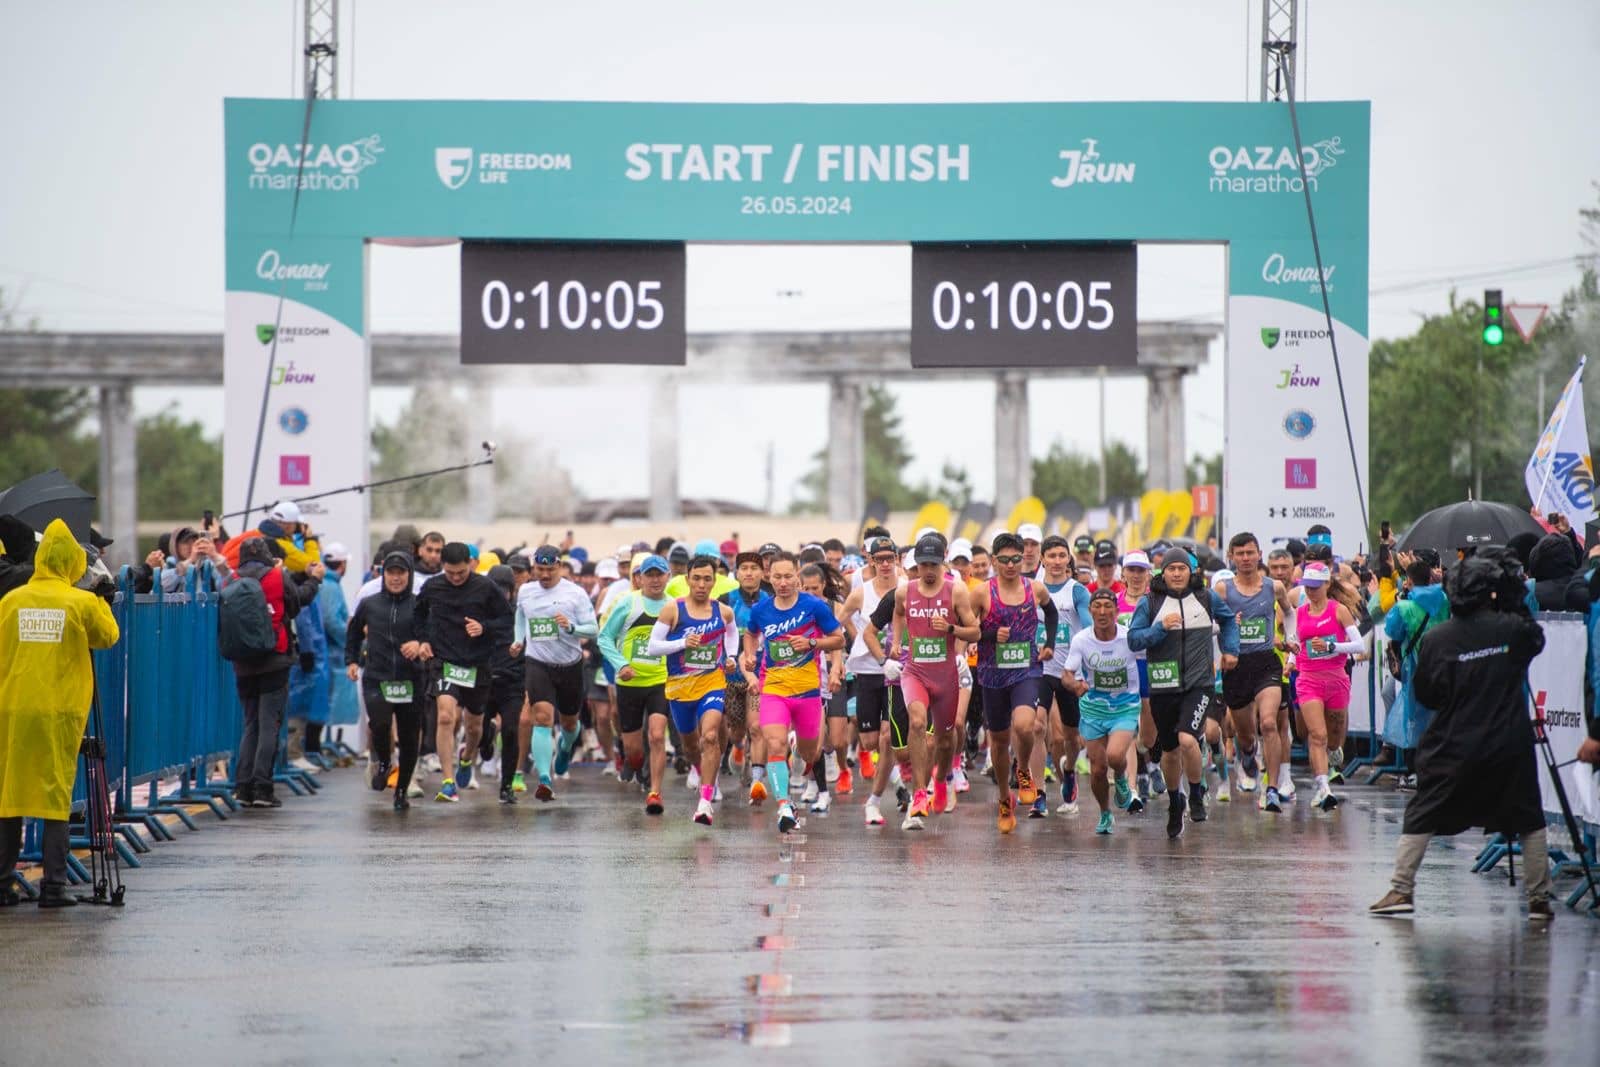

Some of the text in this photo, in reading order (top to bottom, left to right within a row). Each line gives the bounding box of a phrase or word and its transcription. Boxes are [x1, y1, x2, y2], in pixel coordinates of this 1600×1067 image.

[479, 153, 572, 171] FREEDOM
[625, 143, 970, 184] START / FINISH
[249, 171, 359, 191] marathon
[479, 171, 508, 184] LIFE
[1209, 173, 1319, 193] marathon
[741, 196, 852, 214] 26.05.2024
[481, 280, 665, 330] 0:10:05
[932, 281, 1115, 331] 0:10:05
[280, 327, 330, 336] FREEDOM
[909, 607, 949, 618] QATAR
[1191, 694, 1210, 730] adidas
